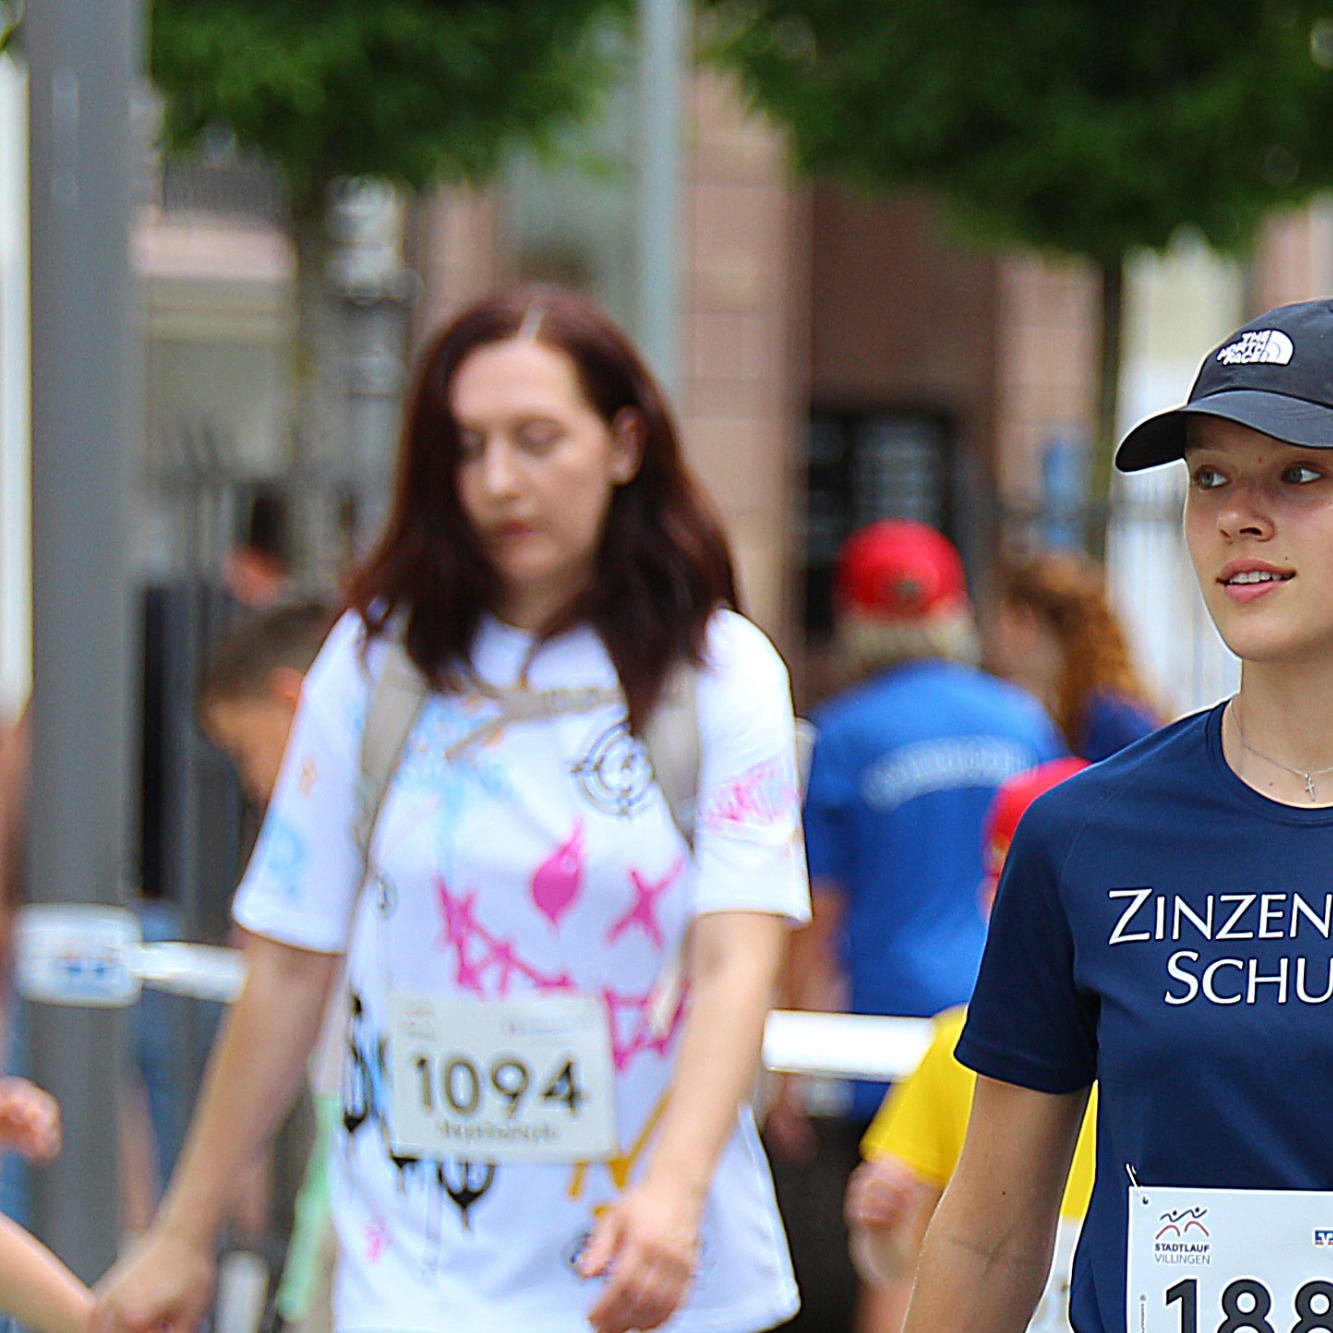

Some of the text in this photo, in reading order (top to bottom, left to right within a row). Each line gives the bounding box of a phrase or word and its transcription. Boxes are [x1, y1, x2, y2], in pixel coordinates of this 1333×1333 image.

[415, 1056, 591, 1118] 1094
[1154, 1242, 1210, 1253] STADTLAUF
[1154, 1253, 1211, 1265] VILLINGEN
